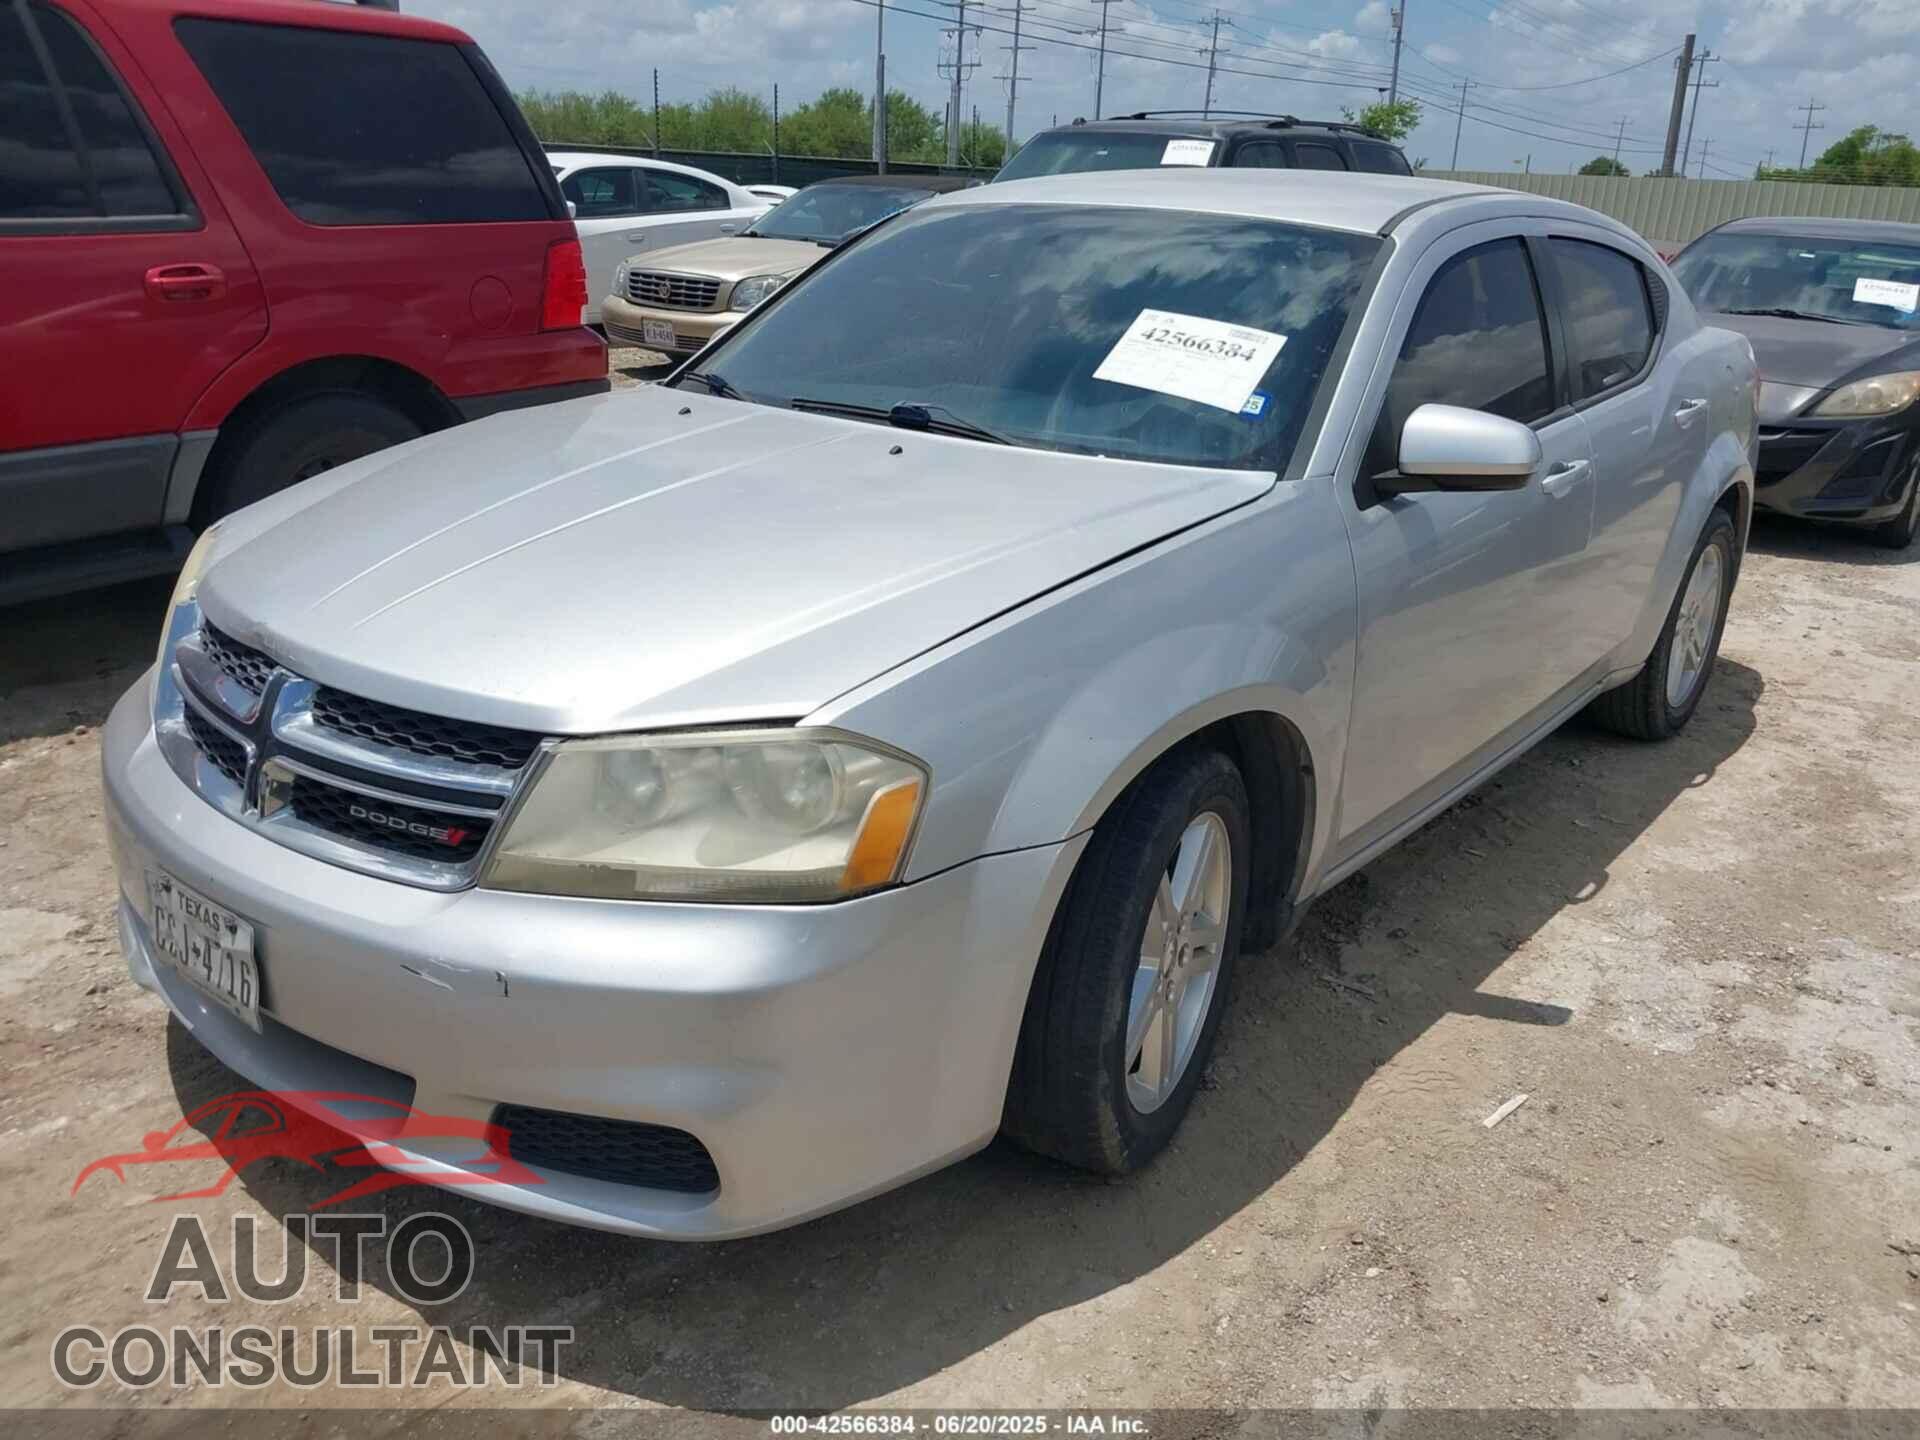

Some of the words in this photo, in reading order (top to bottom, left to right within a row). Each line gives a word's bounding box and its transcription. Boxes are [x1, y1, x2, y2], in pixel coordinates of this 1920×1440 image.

[1140, 326, 1257, 362] 42566384
[349, 804, 449, 841] DODGE
[177, 891, 221, 932] TEXAS
